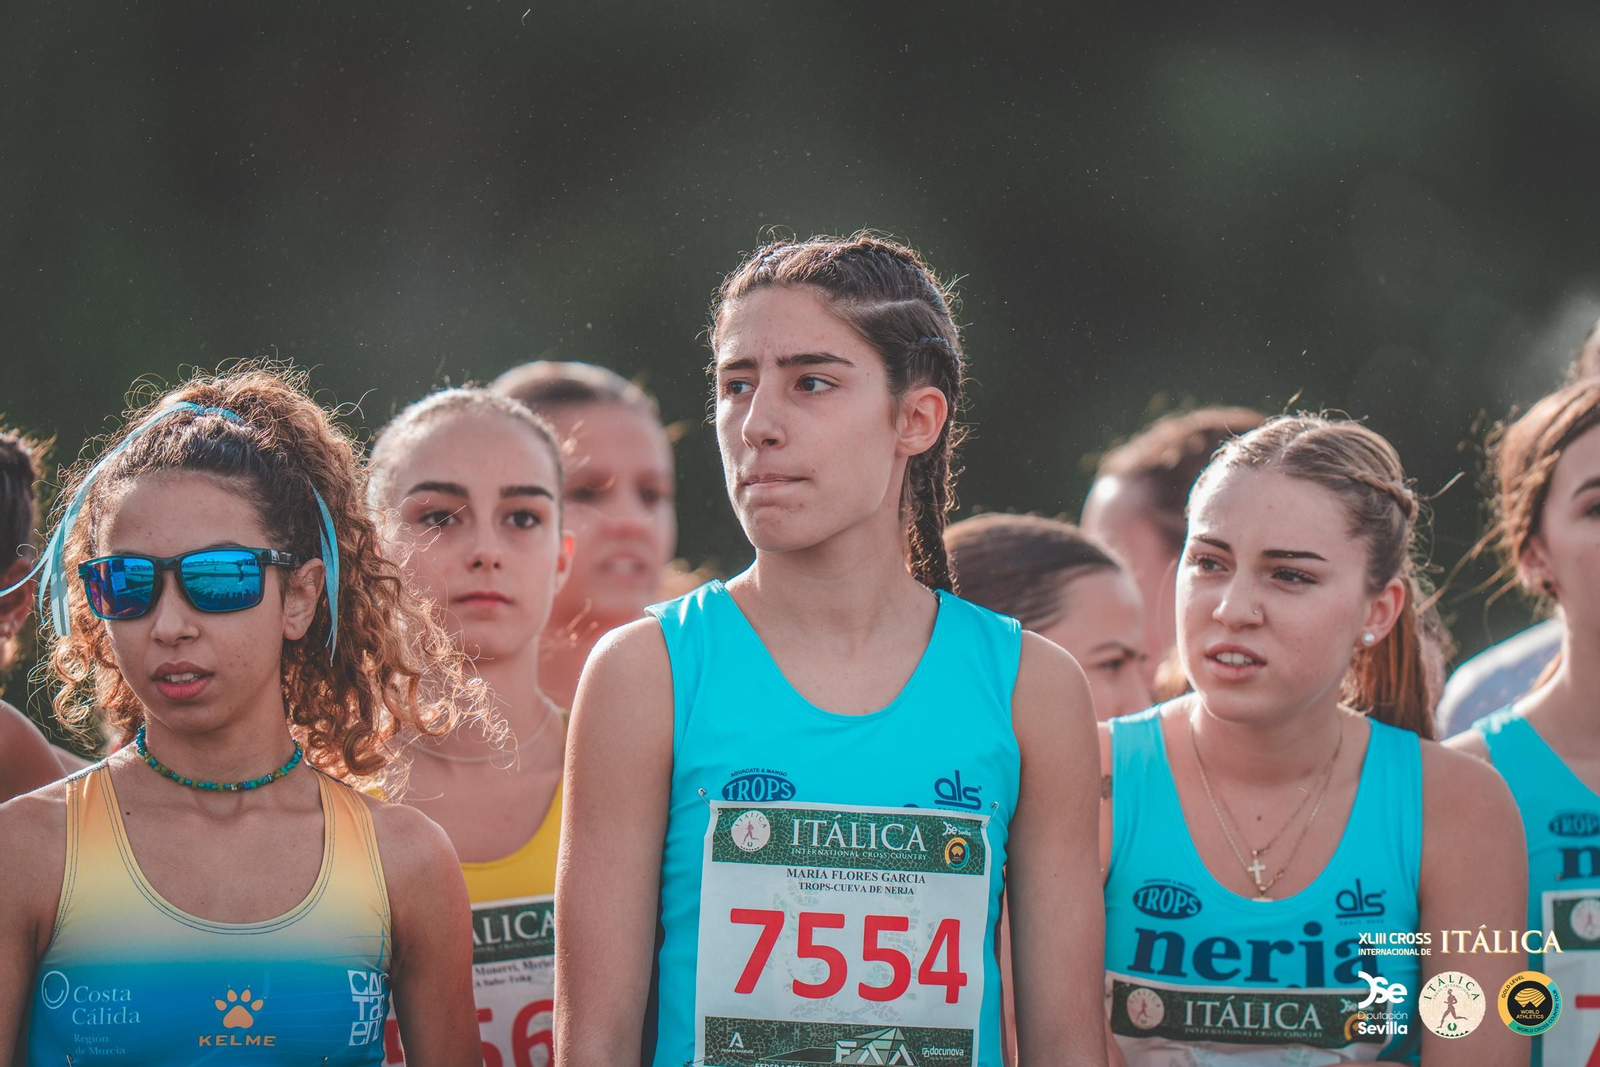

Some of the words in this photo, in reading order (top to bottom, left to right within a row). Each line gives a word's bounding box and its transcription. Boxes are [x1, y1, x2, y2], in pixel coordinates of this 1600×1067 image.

[730, 768, 760, 777] AGUACATE
[767, 769, 787, 777] MANGO
[725, 776, 792, 801] TROPS
[934, 769, 982, 810] als
[790, 813, 927, 852] ITÁLICA
[791, 847, 860, 858] INTERNATIONAL
[862, 850, 888, 858] CROSS
[890, 851, 927, 861] COUNTRY
[786, 868, 828, 880] MARIA
[831, 870, 879, 882] FLORES
[881, 872, 926, 884] GARCIA
[798, 881, 867, 893] TROPS-CUEVA
[869, 884, 881, 893] DE
[884, 886, 915, 895] NERJA
[1136, 887, 1199, 915] TROPS
[1335, 878, 1385, 918] als
[730, 908, 968, 1004] 7554
[74, 985, 131, 1003] Costa
[72, 1006, 140, 1025] Cálida
[1184, 995, 1323, 1030] ITÁLICA
[74, 1033, 109, 1045] Región
[199, 1035, 277, 1047] KELME
[75, 1047, 87, 1055] de
[89, 1046, 126, 1055] Murcia
[929, 1046, 964, 1056] docunova
